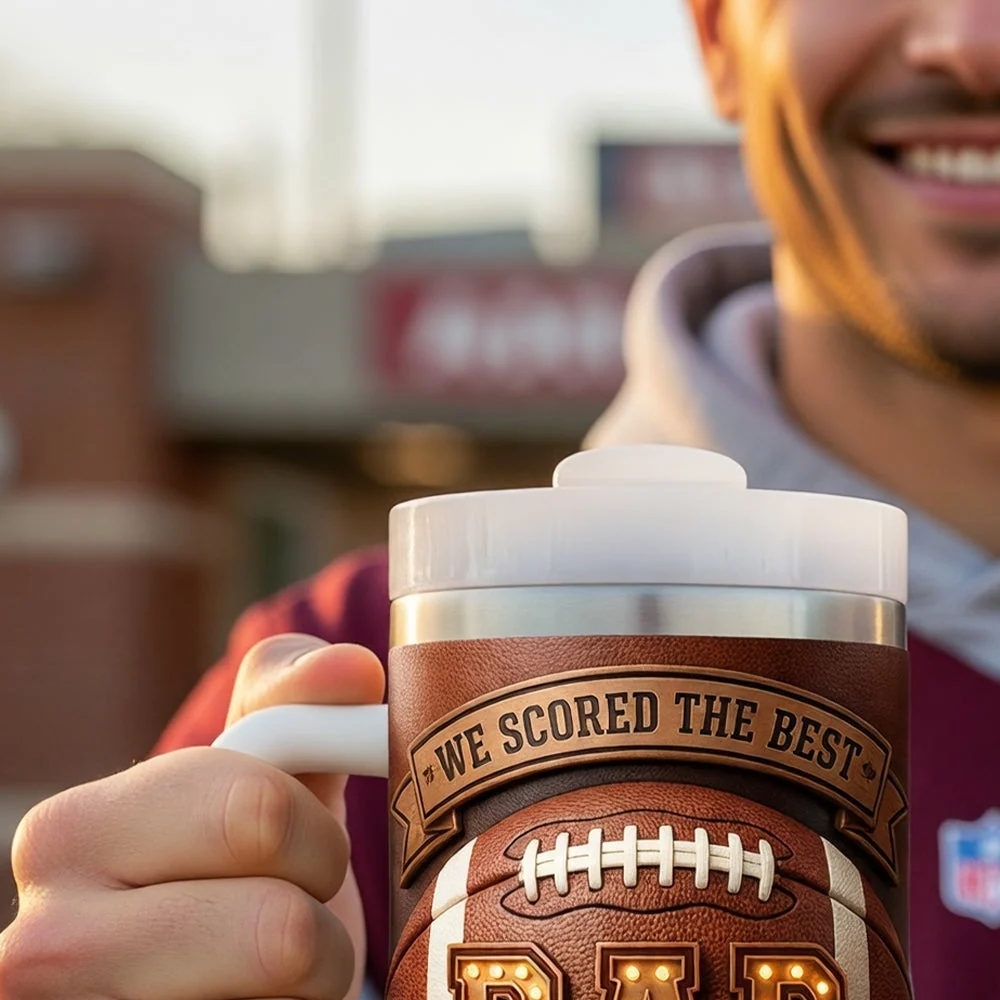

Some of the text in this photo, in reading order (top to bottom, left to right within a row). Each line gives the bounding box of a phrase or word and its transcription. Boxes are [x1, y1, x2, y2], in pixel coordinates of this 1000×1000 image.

[434, 690, 864, 783] WE SCORED THE BEST
